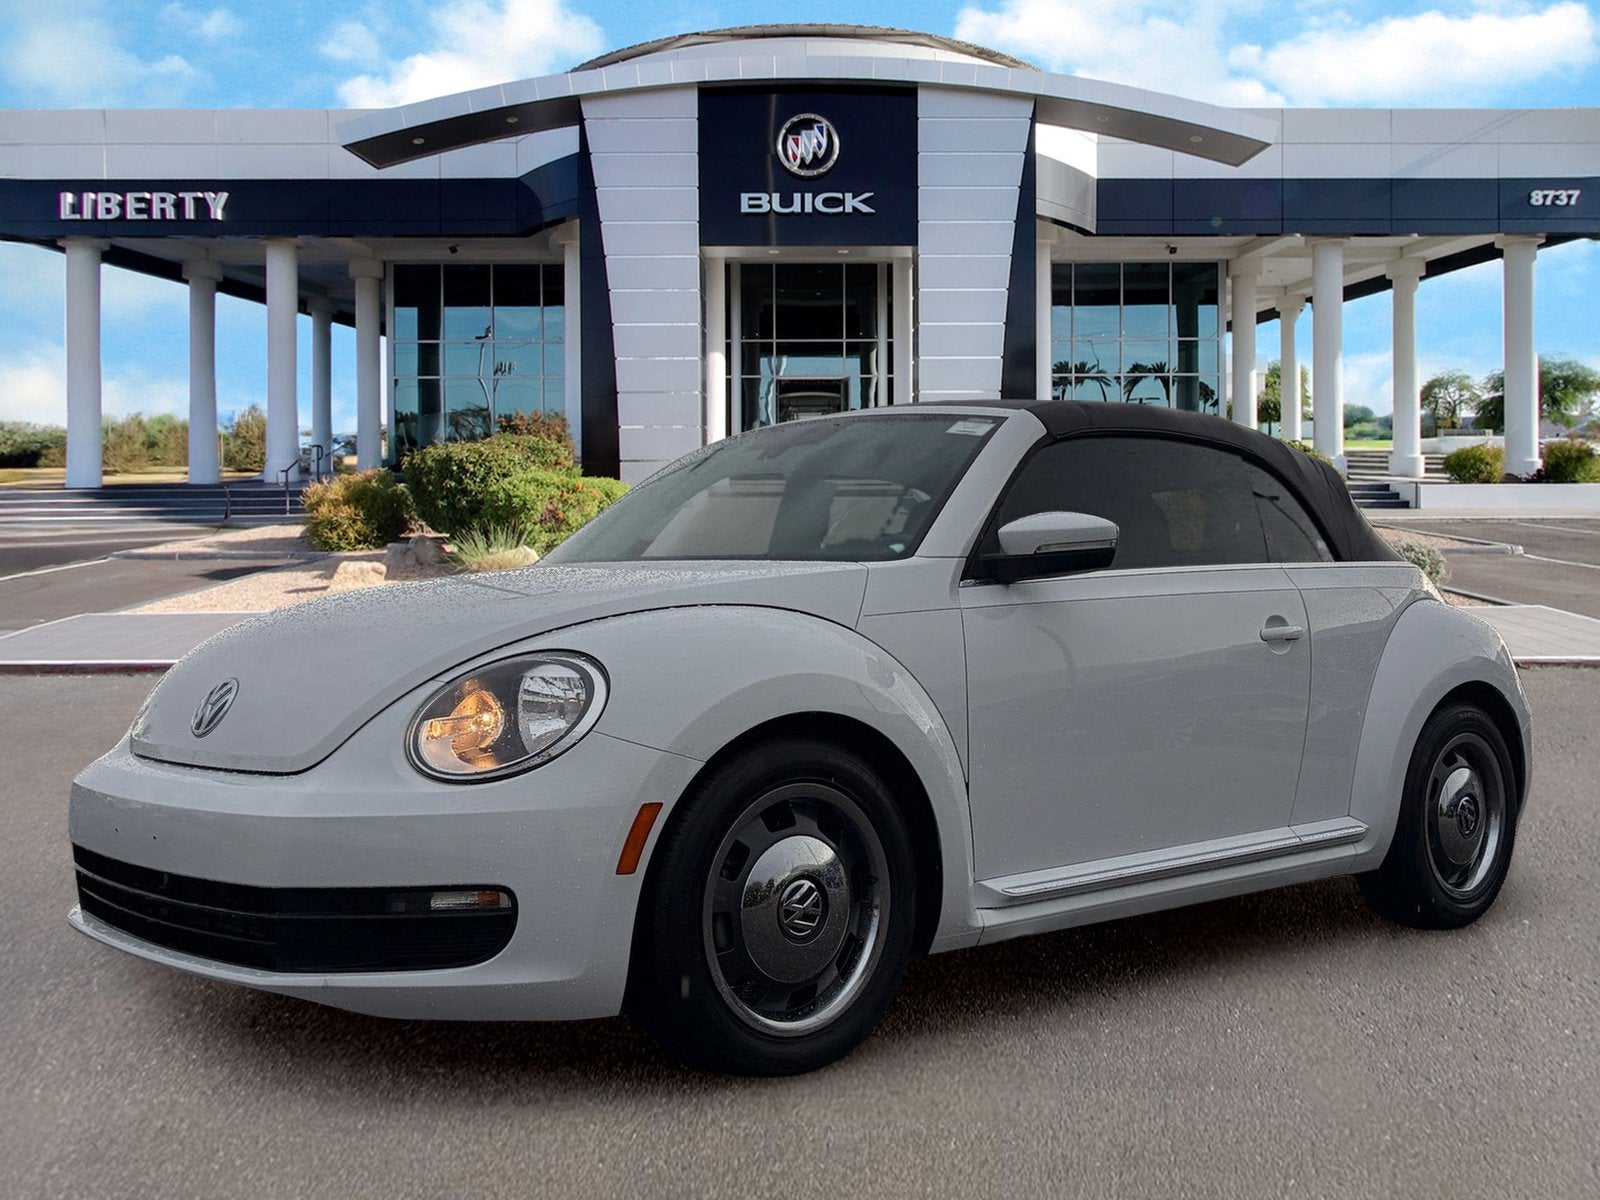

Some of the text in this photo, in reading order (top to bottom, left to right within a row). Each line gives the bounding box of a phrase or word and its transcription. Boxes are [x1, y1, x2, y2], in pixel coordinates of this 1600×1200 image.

[59, 191, 229, 220] LIBERTY
[740, 192, 876, 214] BUICK
[1529, 189, 1581, 206] 8737
